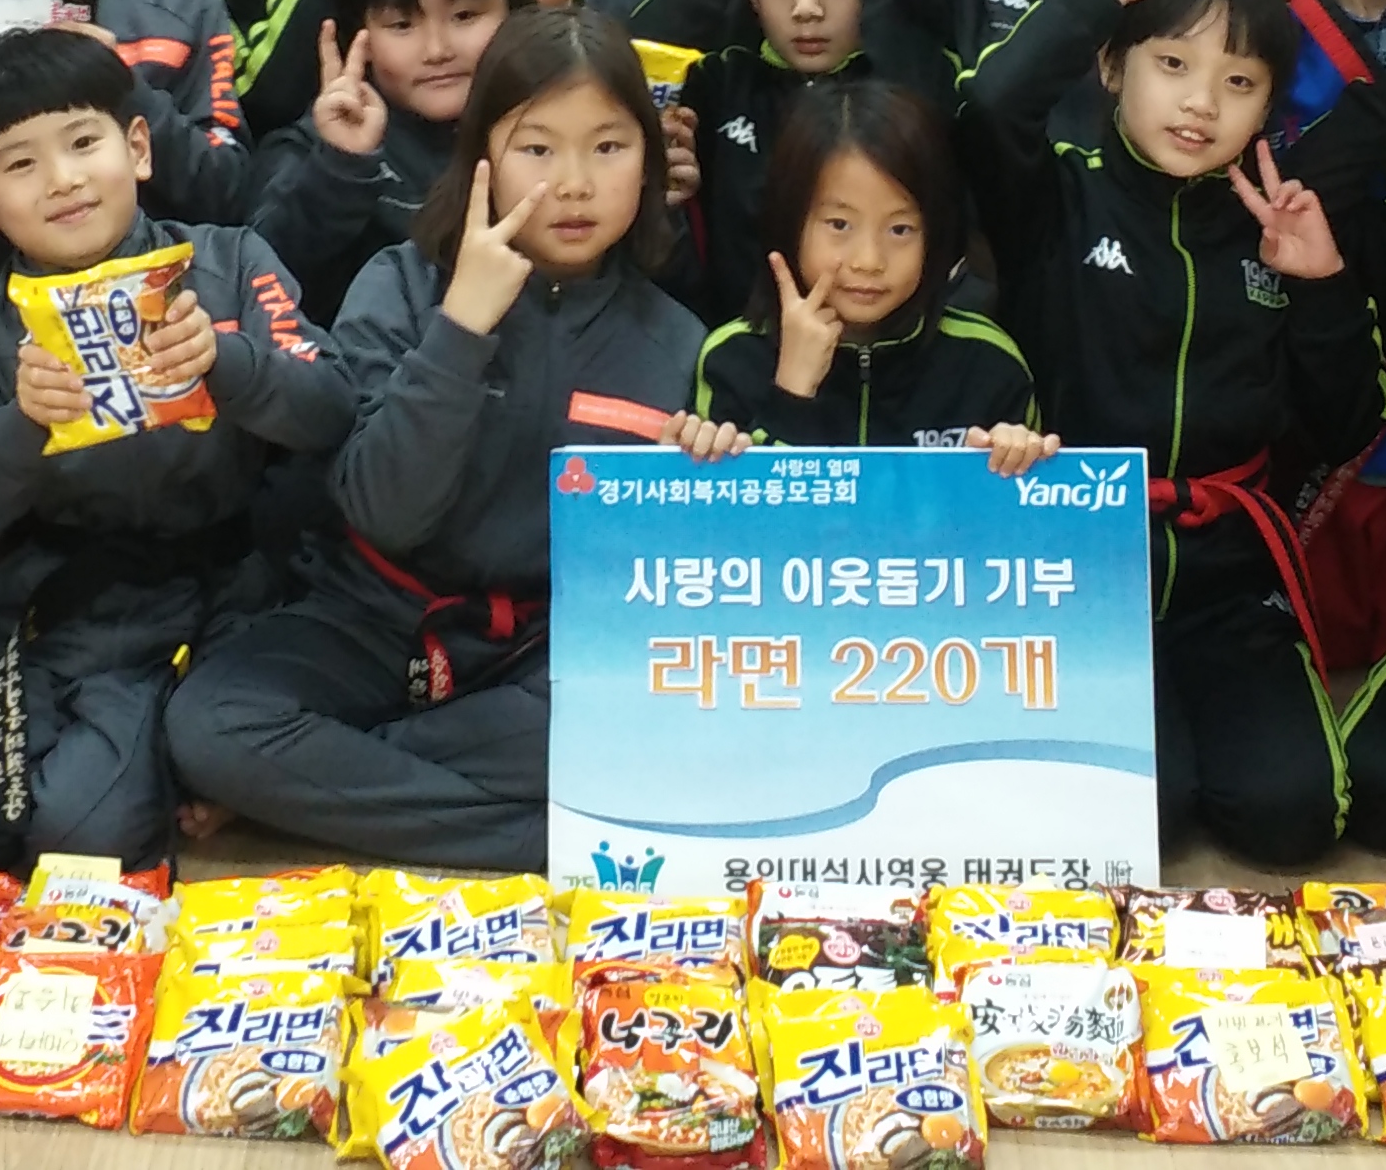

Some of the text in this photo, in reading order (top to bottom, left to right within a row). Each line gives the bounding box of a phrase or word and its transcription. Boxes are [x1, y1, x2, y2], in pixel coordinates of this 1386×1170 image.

[208, 33, 241, 129] ITALIA
[1240, 258, 1281, 292] 1967
[65, 306, 148, 430] 진라면
[912, 427, 966, 448] 1967
[597, 479, 859, 506] 경기사회복지공동모금회
[770, 458, 862, 477] 사랑의 열매
[623, 556, 1077, 608] 사랑의 이웃돕기 기부
[647, 634, 1059, 711] 라면 220개
[590, 910, 727, 960] 진라면
[177, 1002, 329, 1056] 진라면
[599, 1007, 736, 1053] 너구리
[387, 1027, 530, 1137] 진라면
[800, 1039, 946, 1108] 진라면
[905, 1088, 956, 1110] 순한맛
